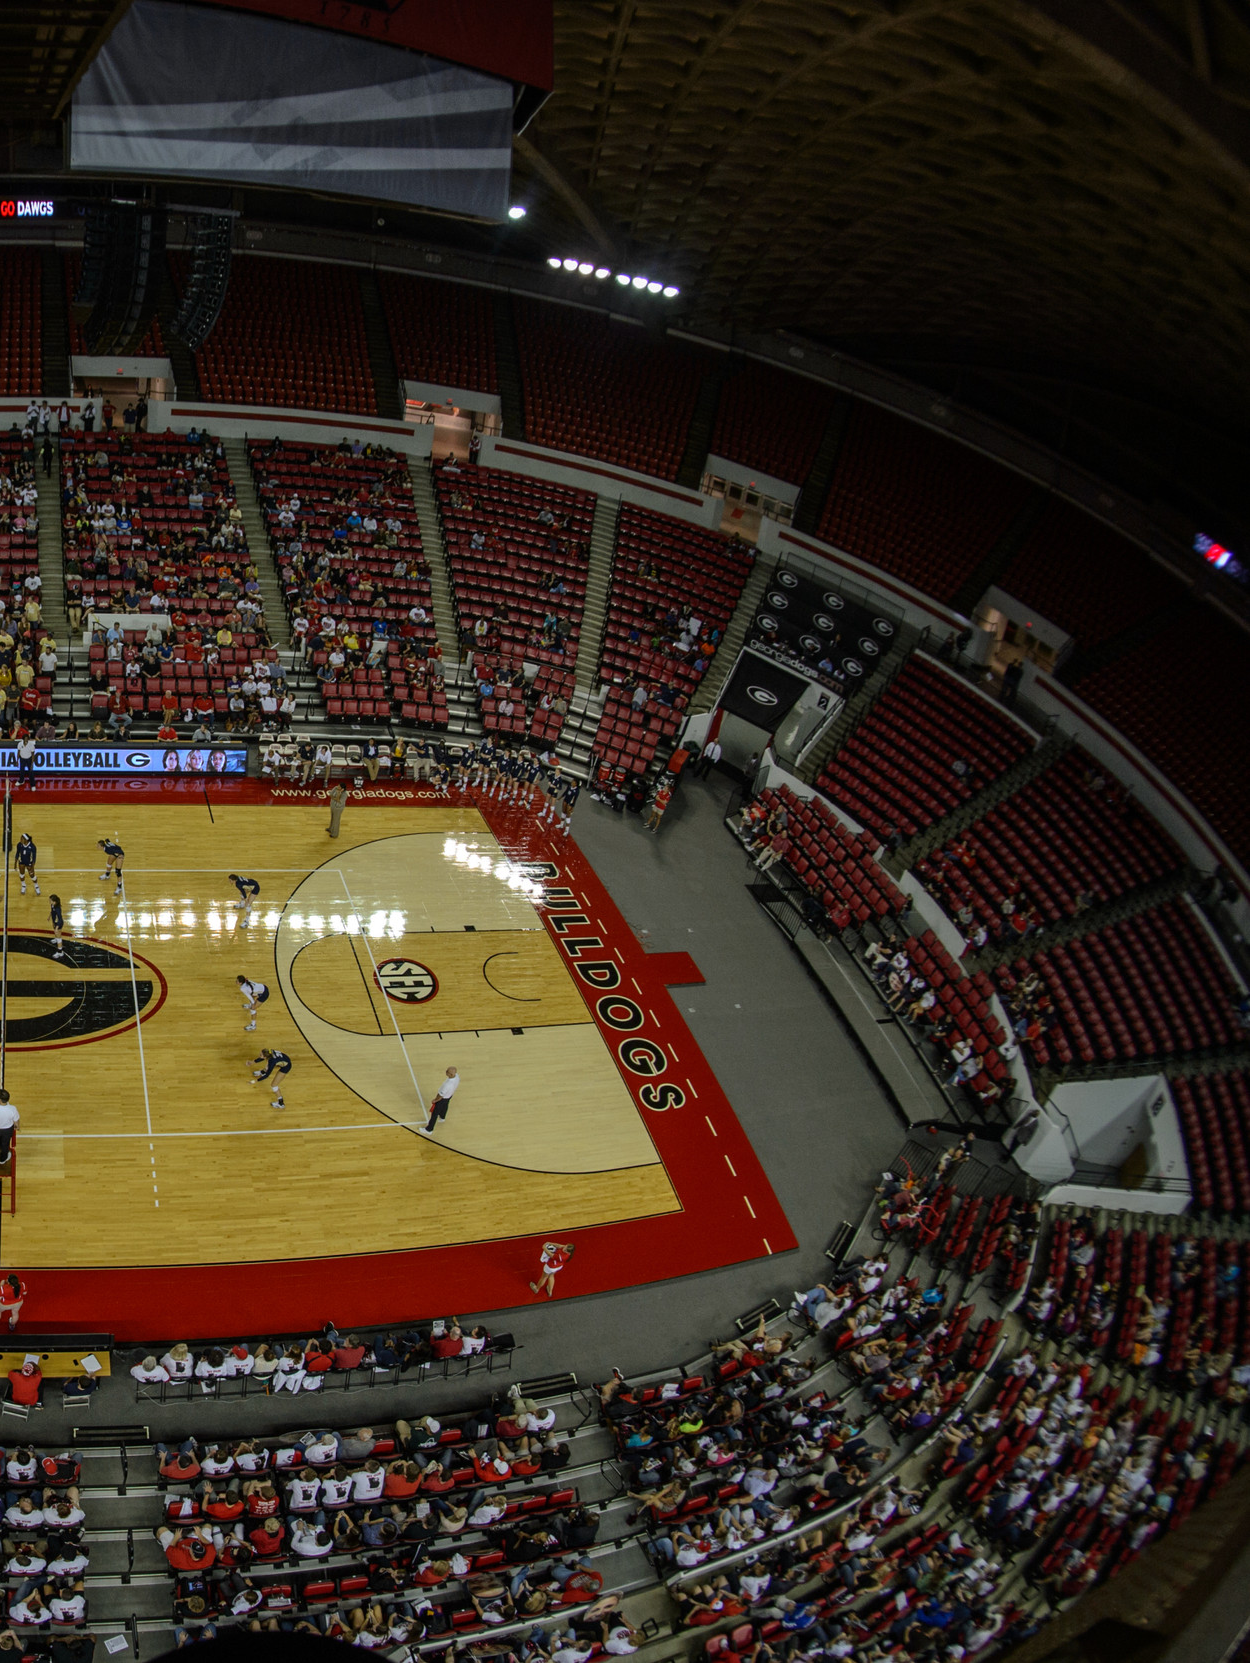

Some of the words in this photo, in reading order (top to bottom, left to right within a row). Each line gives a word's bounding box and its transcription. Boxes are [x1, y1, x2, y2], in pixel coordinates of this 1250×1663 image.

[0, 201, 15, 217] GO
[17, 201, 54, 217] DAWGS
[31, 752, 120, 768] OLLEYBALL
[375, 958, 439, 1003] SEC
[522, 862, 686, 1112] BULLDOGS
